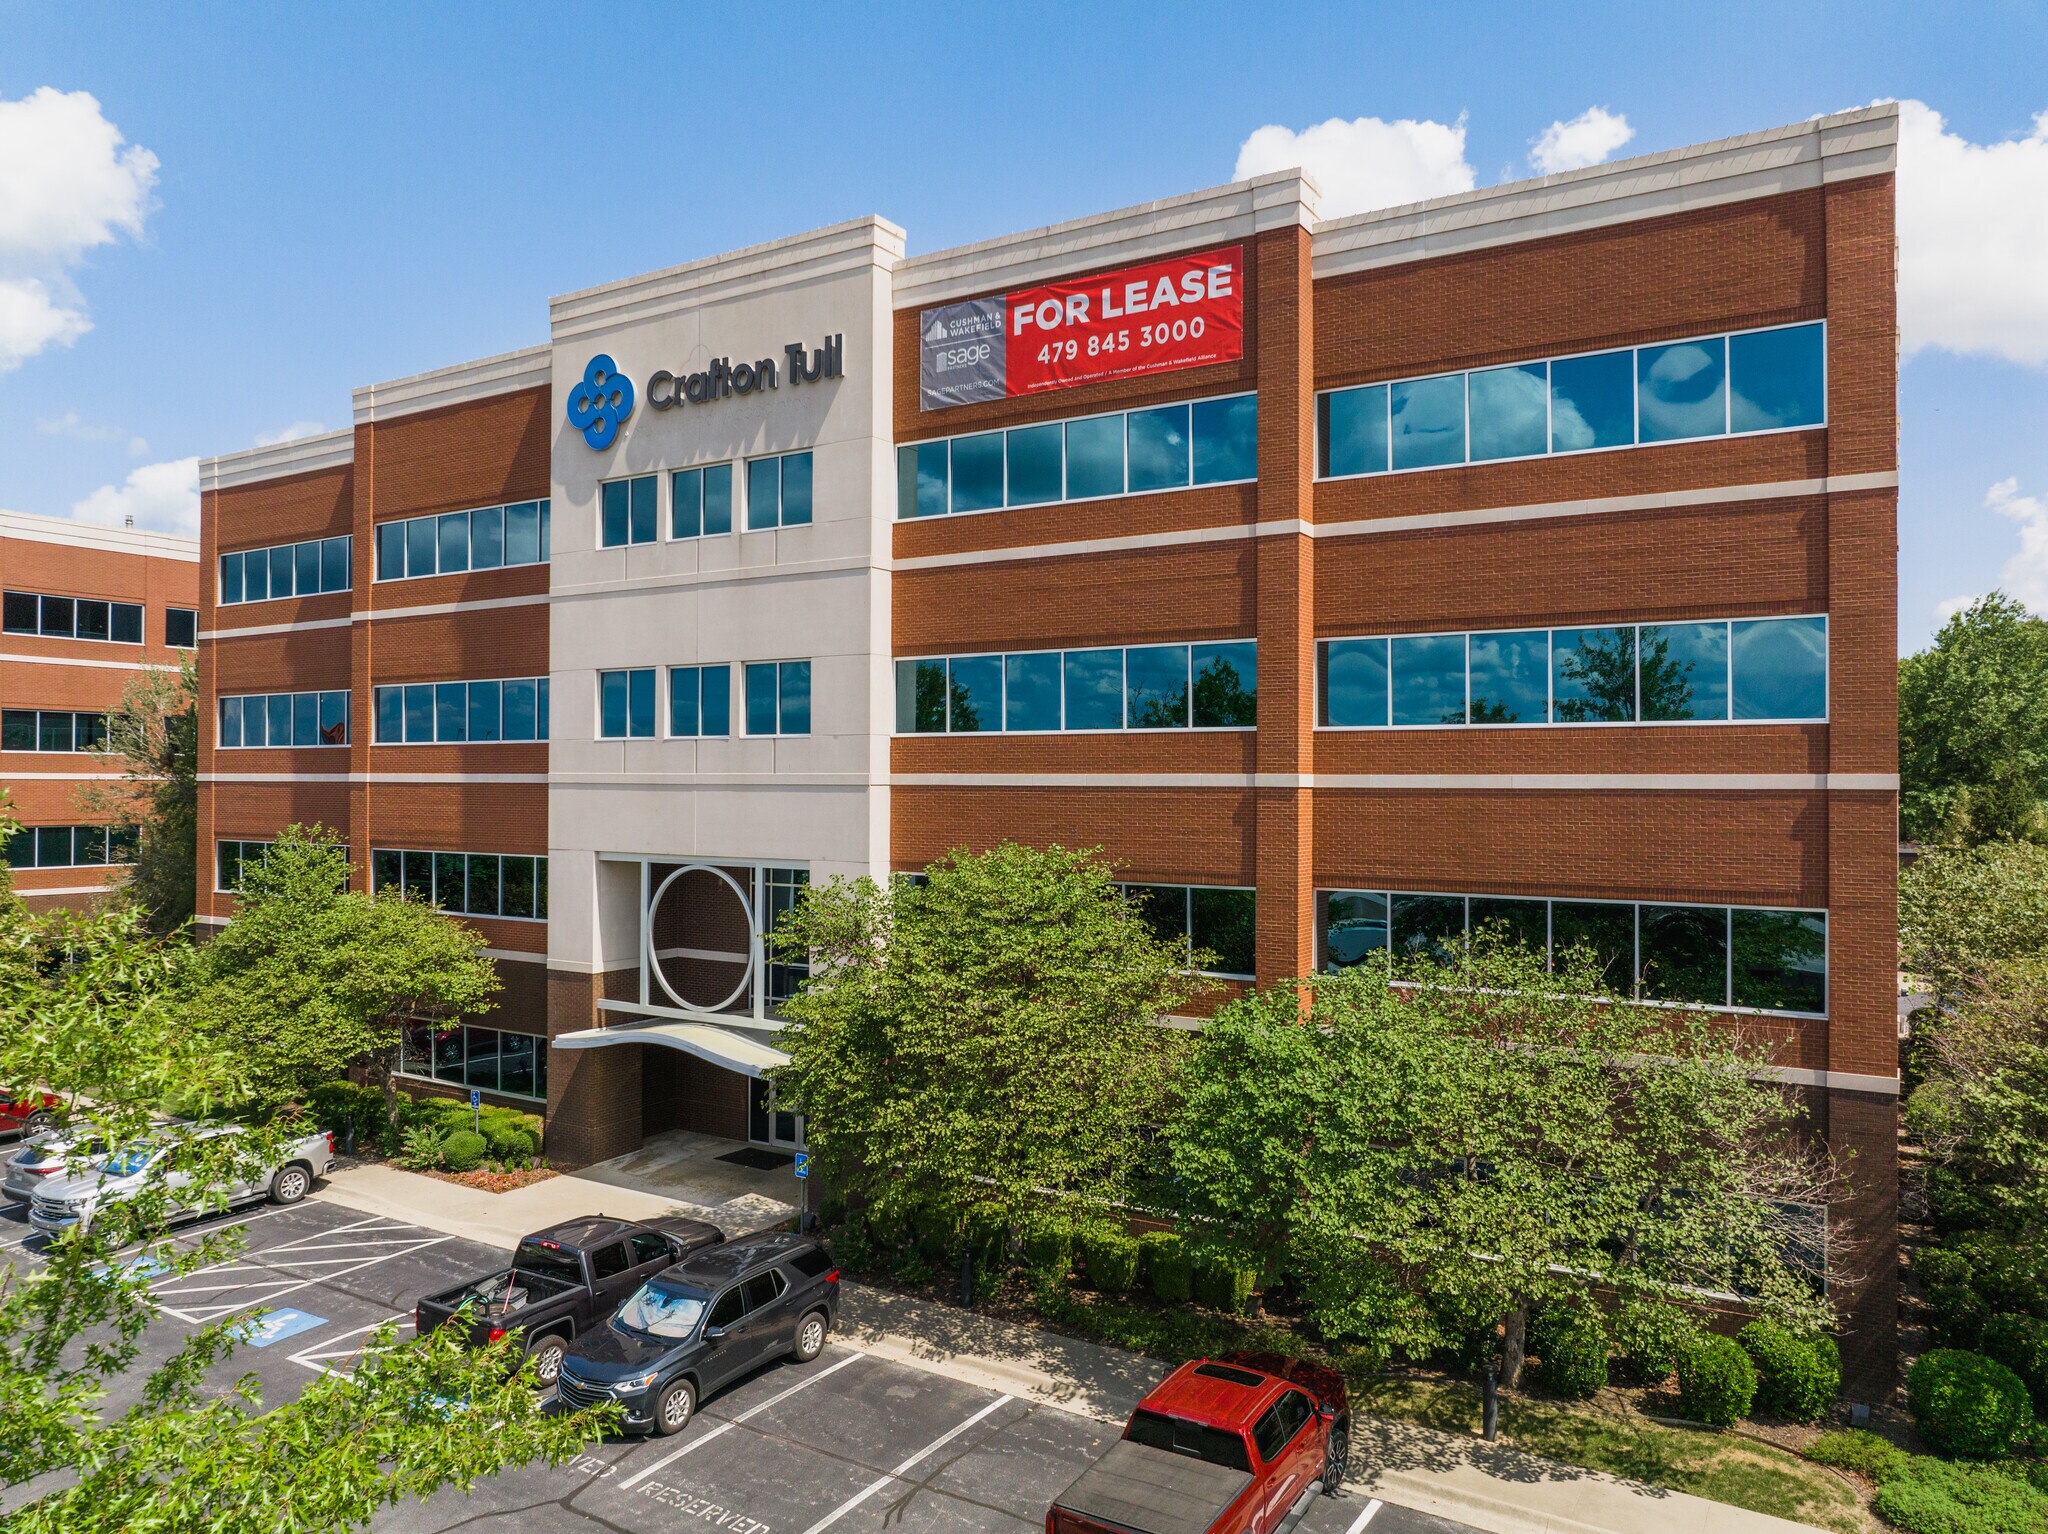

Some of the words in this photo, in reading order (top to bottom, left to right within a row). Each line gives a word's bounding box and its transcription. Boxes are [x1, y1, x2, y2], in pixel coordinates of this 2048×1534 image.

[1013, 293, 1090, 337] FOR
[1102, 264, 1233, 319] LEASE
[950, 314, 993, 329] CUSHMAN
[994, 311, 1001, 320] &
[950, 320, 1001, 337] WAKEFIELD
[947, 343, 991, 366] sage
[1037, 339, 1078, 364] 479
[1087, 329, 1130, 357] 845
[1140, 316, 1205, 348] 3000
[647, 356, 778, 411] Crafton
[784, 332, 845, 386] Tull
[927, 378, 1000, 397] SAGEPARTNERS.COM
[1027, 380, 1057, 389] Independently
[1083, 371, 1104, 380] Operated
[1146, 361, 1168, 369] Cushman
[1173, 356, 1197, 364] Wakefield
[637, 1481, 771, 1534] RESERVED
